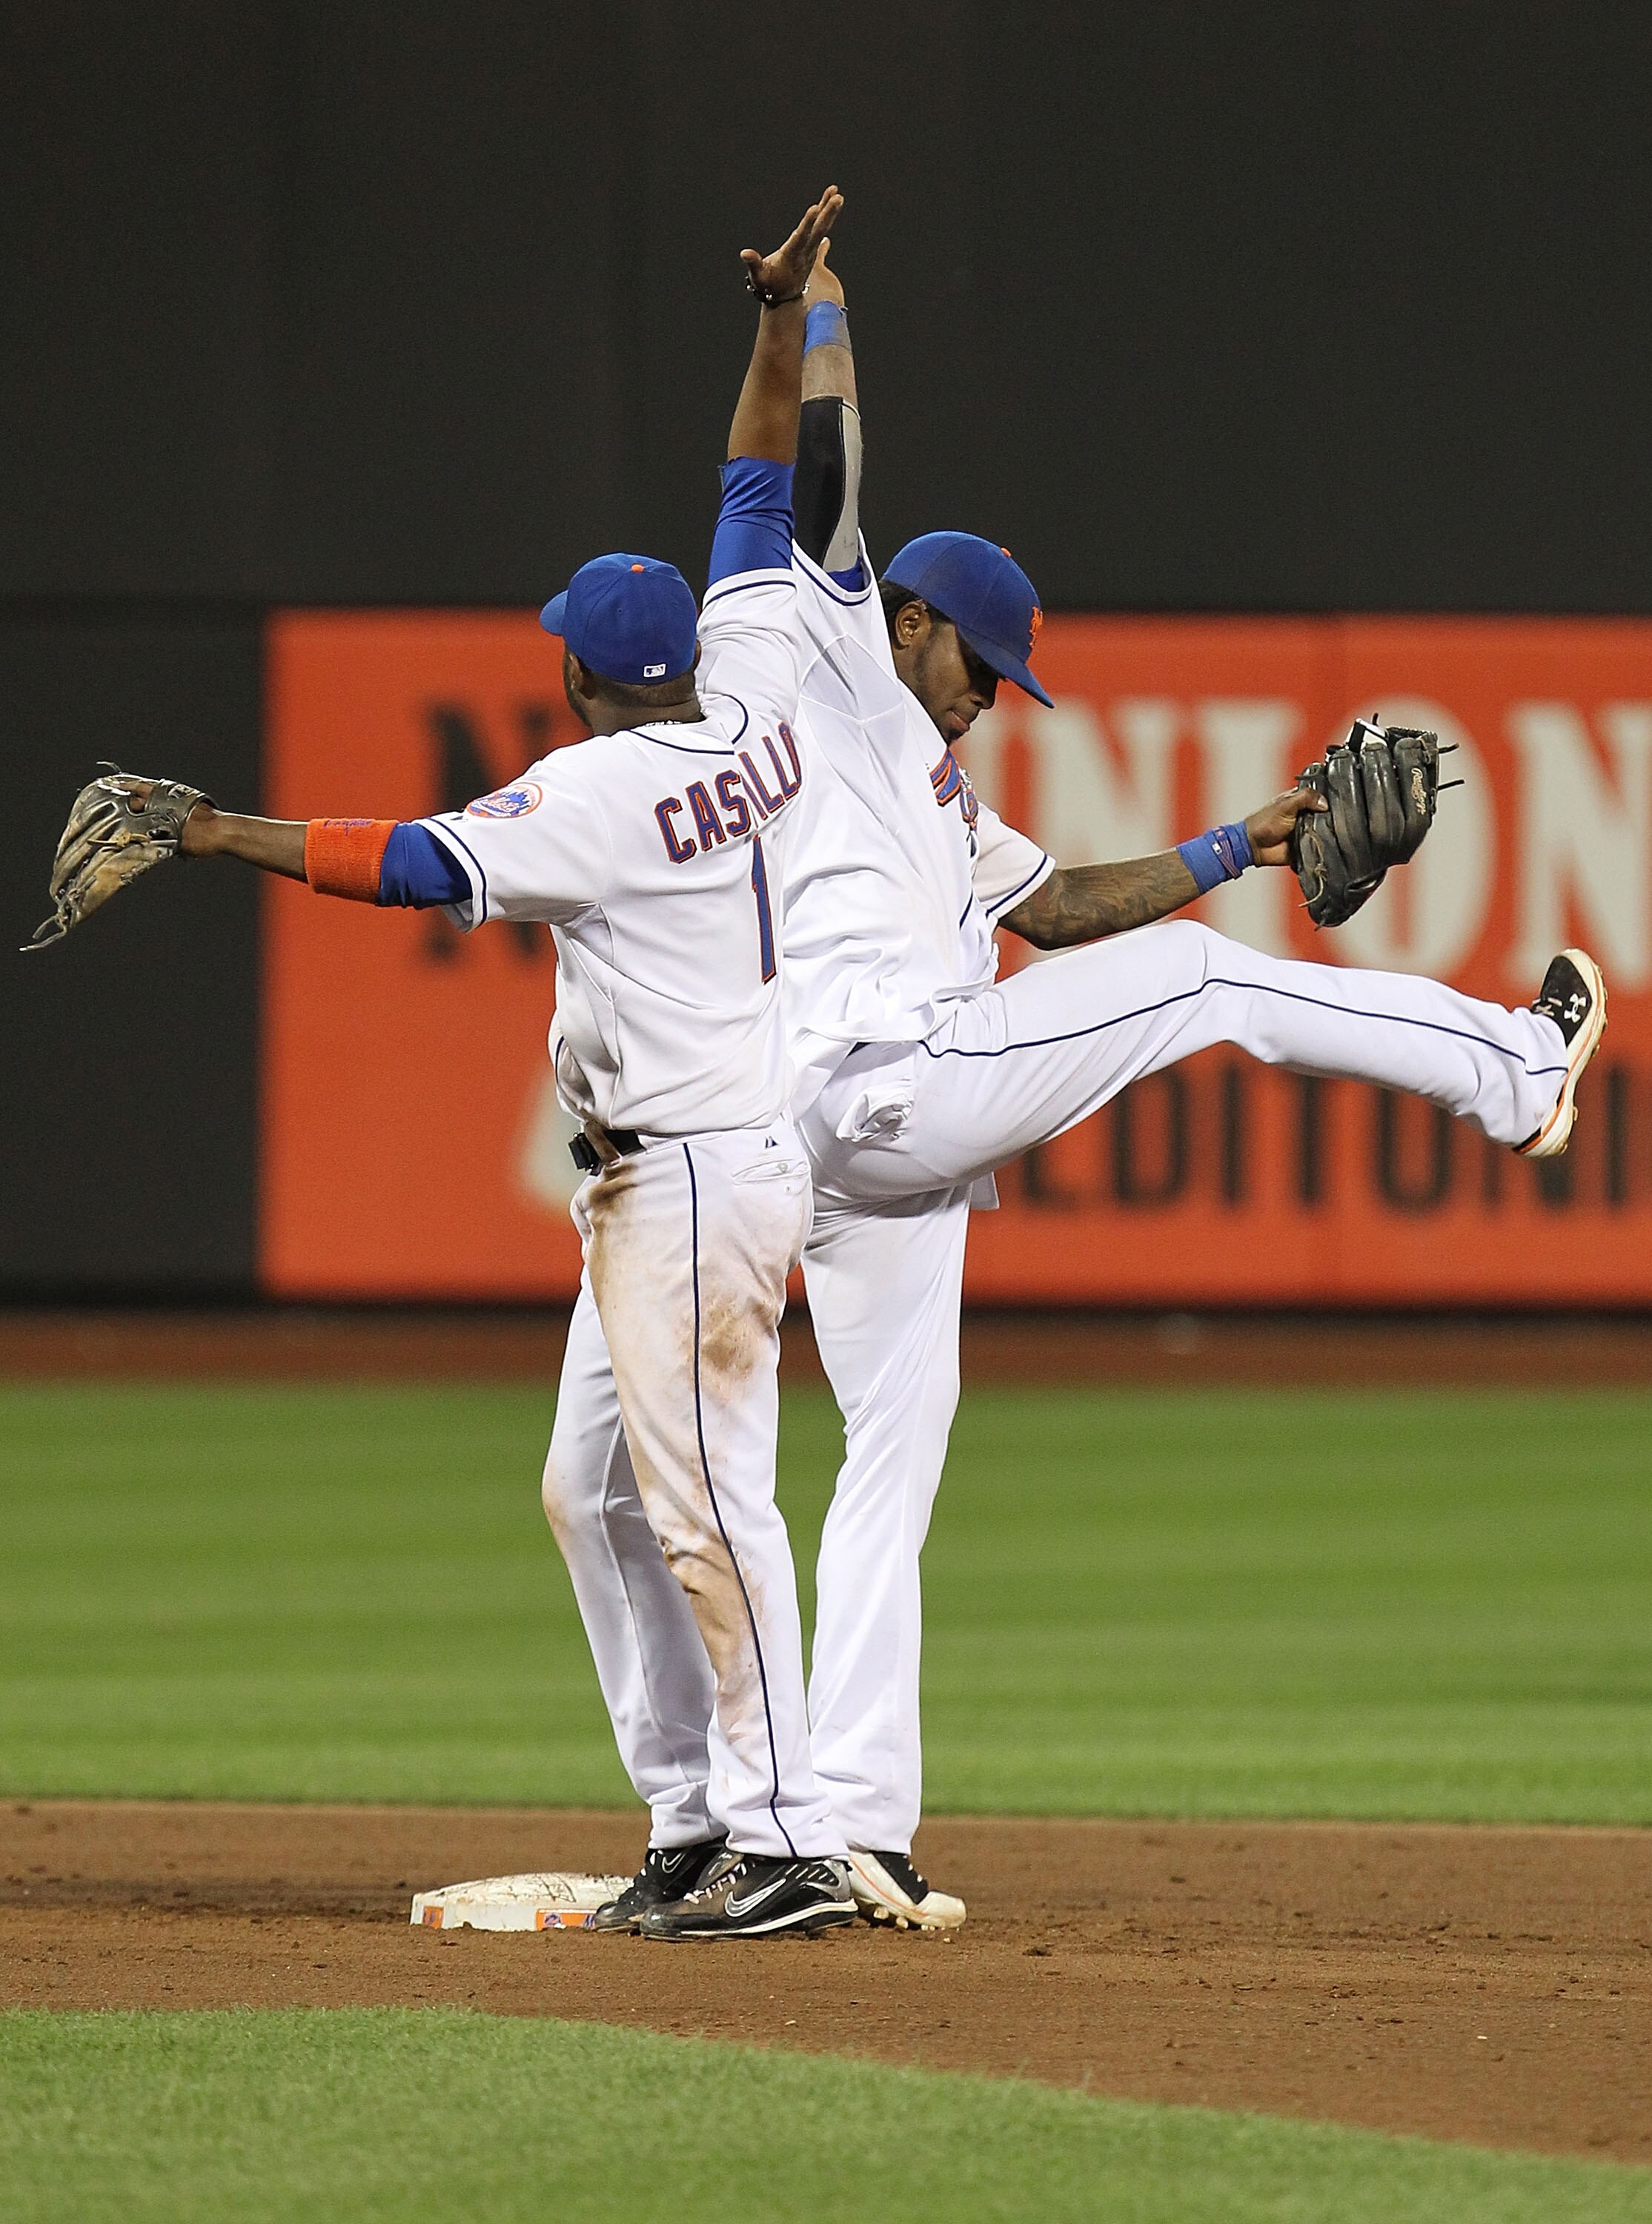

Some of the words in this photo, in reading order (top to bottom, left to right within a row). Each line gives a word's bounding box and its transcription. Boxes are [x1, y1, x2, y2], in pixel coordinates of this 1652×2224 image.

[653, 721, 803, 864] CASILLO
[960, 695, 1652, 986] NION
[752, 833, 777, 985] 1
